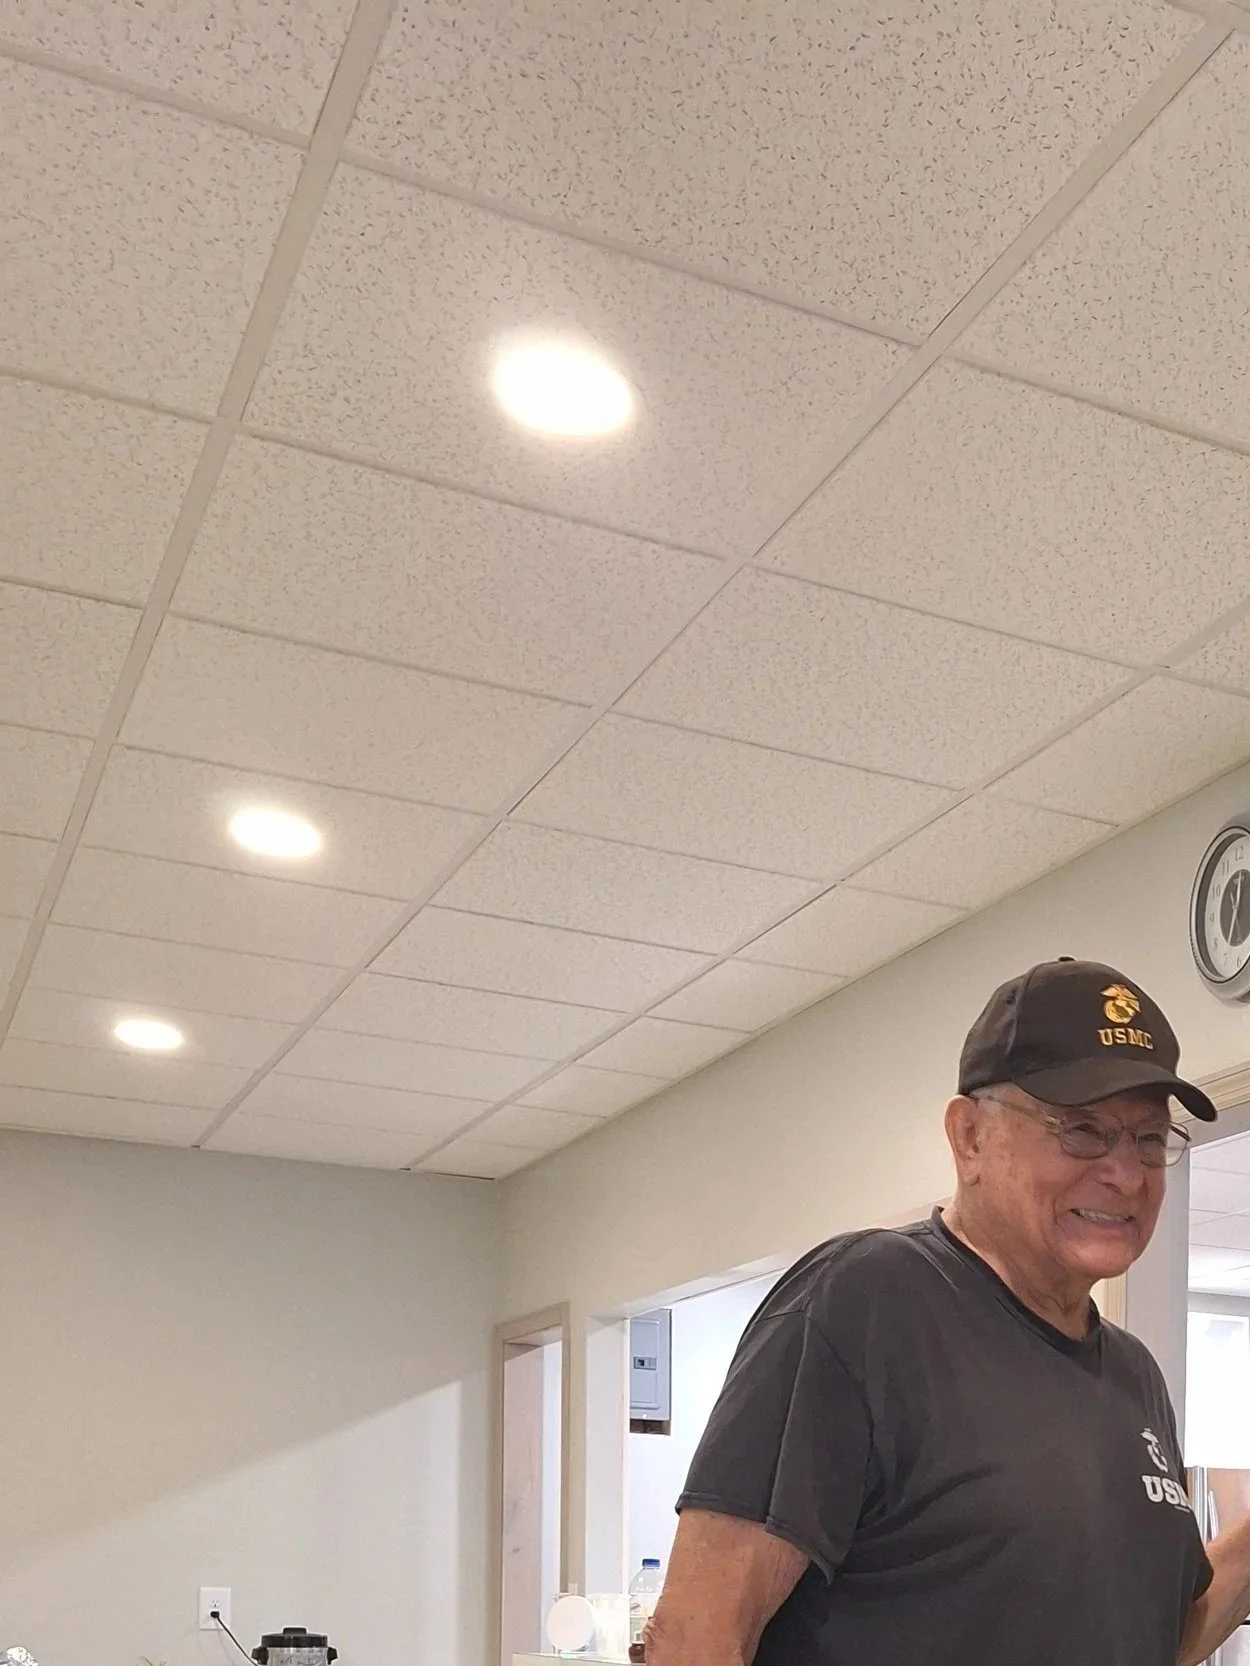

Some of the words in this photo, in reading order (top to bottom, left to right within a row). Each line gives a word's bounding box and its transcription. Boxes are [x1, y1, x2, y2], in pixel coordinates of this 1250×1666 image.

[1234, 845, 1244, 861] 12
[1222, 860, 1230, 876] 11
[1212, 884, 1221, 899] 10
[1097, 1027, 1154, 1050] USMC
